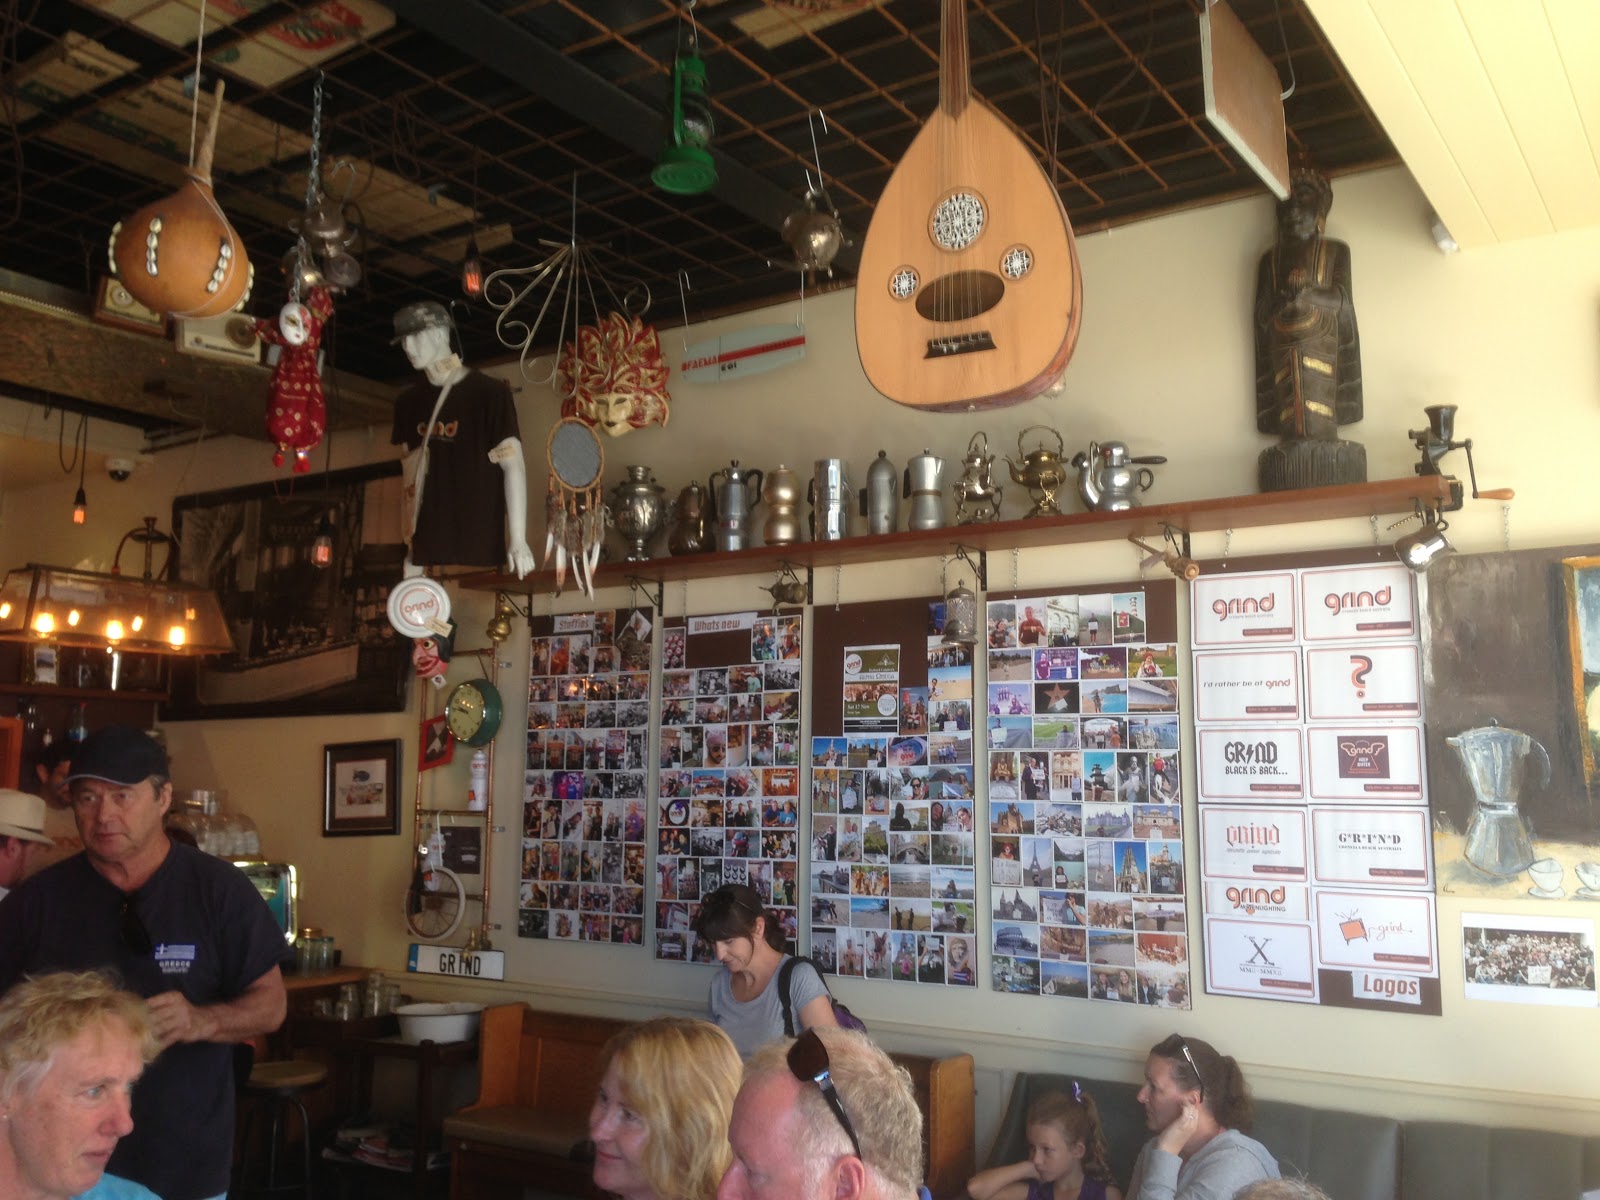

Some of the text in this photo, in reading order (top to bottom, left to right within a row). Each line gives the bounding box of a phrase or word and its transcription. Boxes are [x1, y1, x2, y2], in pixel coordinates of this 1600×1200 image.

[1212, 592, 1275, 621] grind
[1324, 586, 1391, 616] grind
[694, 619, 741, 632] Whats new
[1266, 679, 1291, 689] grind
[1225, 766, 1248, 775] BLACK
[1249, 766, 1257, 775] IS
[1226, 885, 1286, 909] grind
[439, 953, 481, 976] GRIND
[1363, 973, 1417, 998] Logos
